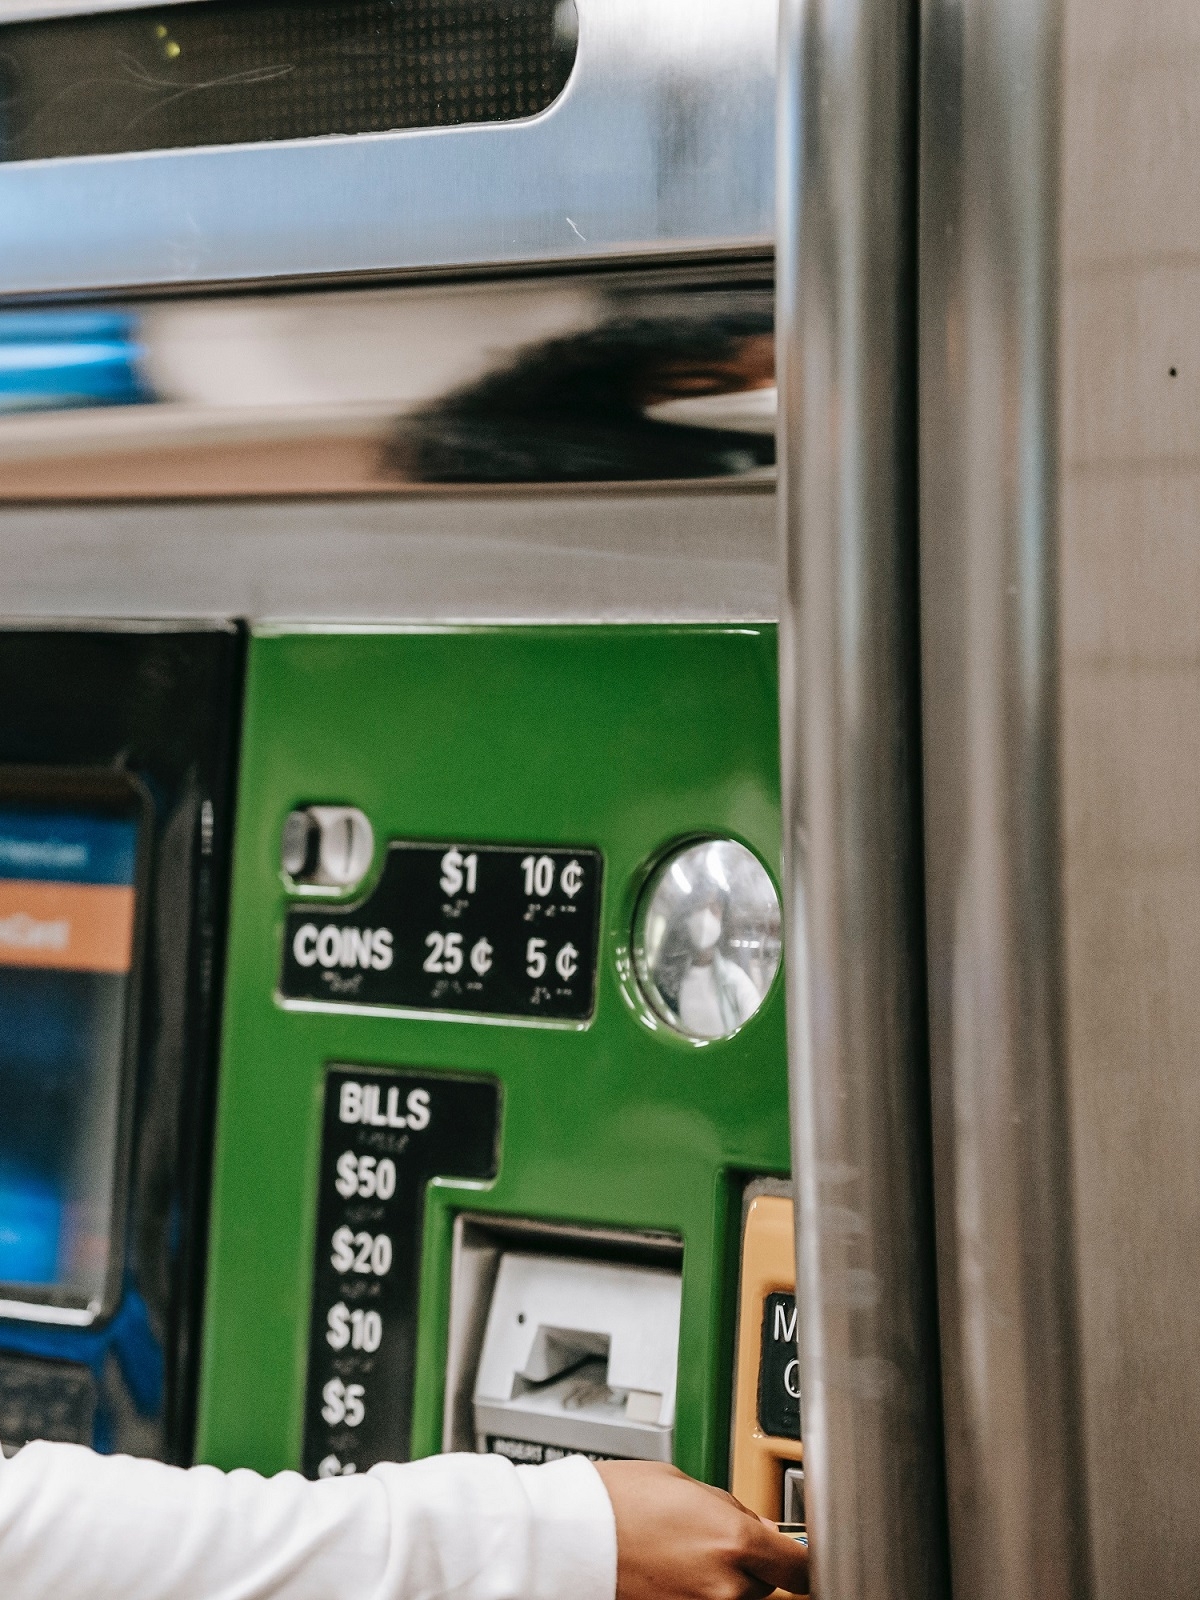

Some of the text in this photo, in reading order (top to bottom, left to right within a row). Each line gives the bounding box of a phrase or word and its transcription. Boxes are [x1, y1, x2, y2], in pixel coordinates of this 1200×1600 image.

[440, 845, 477, 896] $1
[293, 923, 394, 971] COINS
[339, 1082, 431, 1131] BILLS
[335, 1151, 397, 1200] $50
[330, 1226, 393, 1276] $20
[326, 1303, 383, 1353] $10
[321, 1378, 366, 1427] $5
